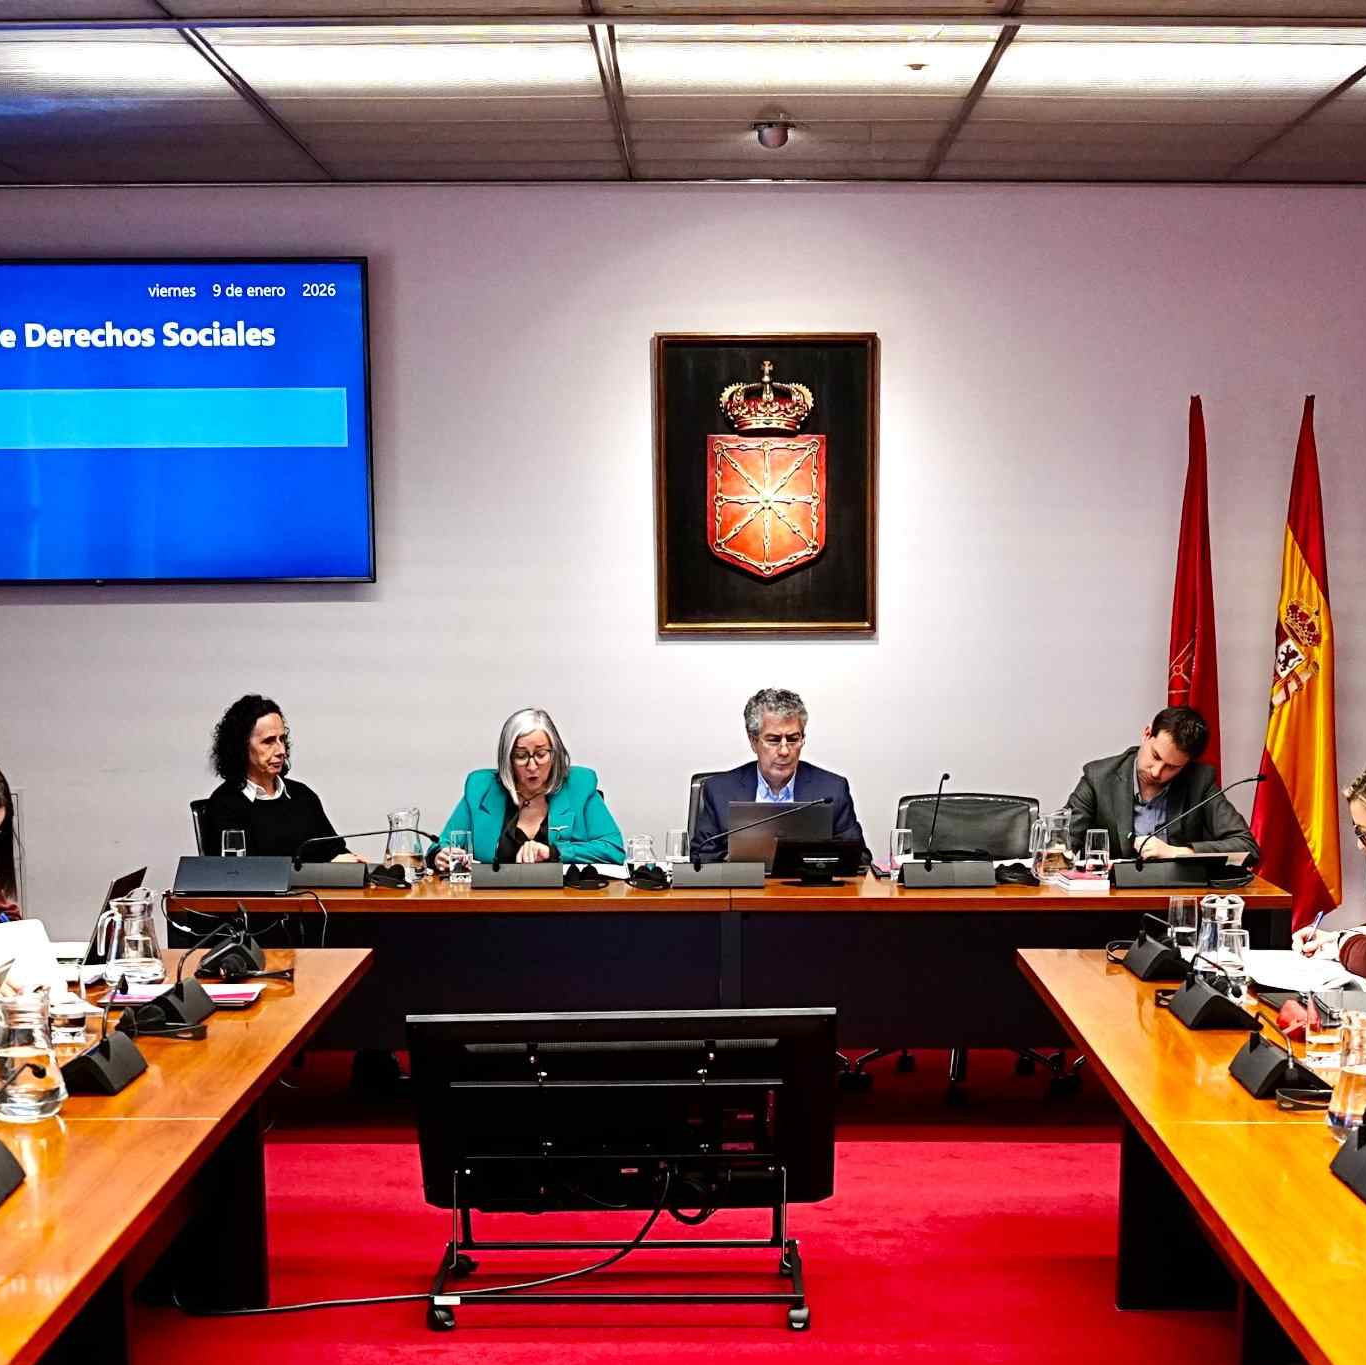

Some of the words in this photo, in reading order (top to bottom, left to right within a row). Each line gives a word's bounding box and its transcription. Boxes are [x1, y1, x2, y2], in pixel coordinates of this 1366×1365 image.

[147, 283, 197, 298] viernes
[212, 283, 222, 297] 9
[225, 283, 243, 297] de
[246, 285, 286, 297] enero
[302, 283, 337, 297] 2026
[24, 320, 156, 349] Derechos
[162, 320, 276, 347] Sociales
